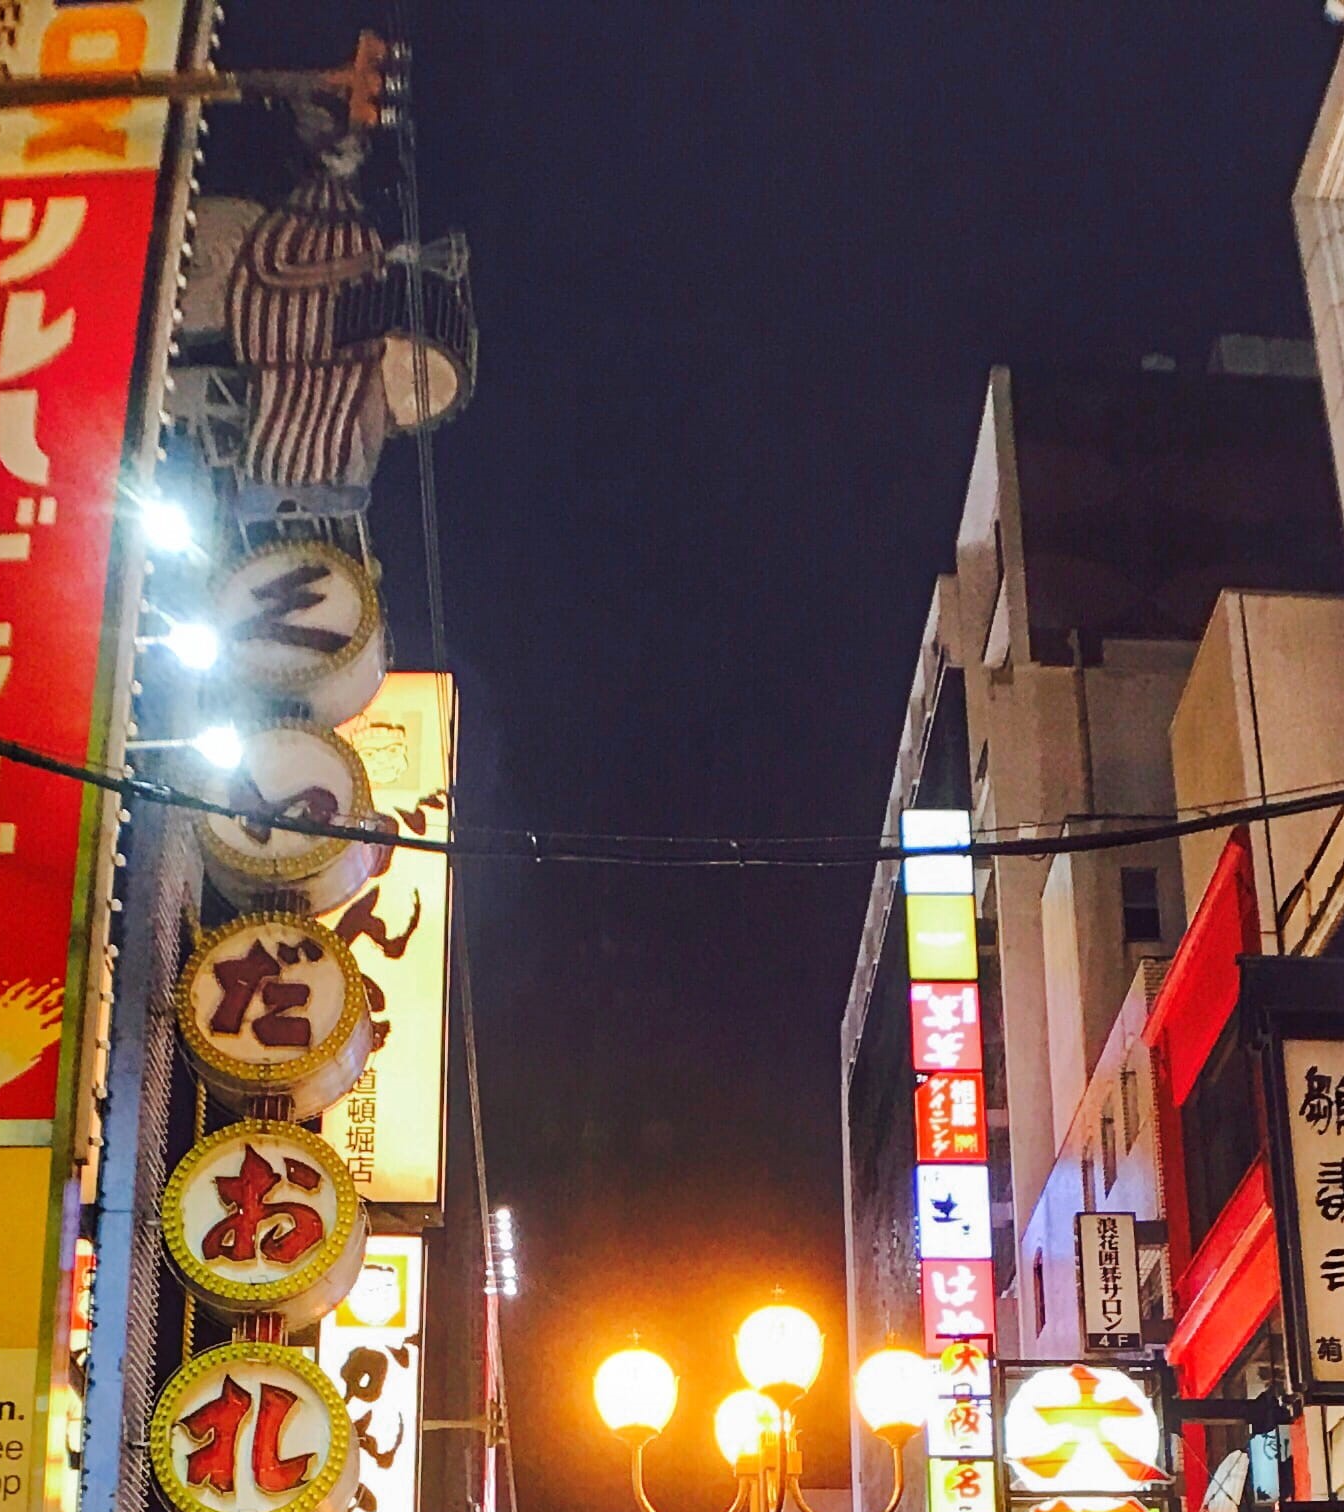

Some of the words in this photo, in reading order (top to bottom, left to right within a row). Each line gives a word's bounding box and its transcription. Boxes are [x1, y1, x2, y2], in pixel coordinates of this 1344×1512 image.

[1097, 1216, 1124, 1332] 浪花囲碁サロン
